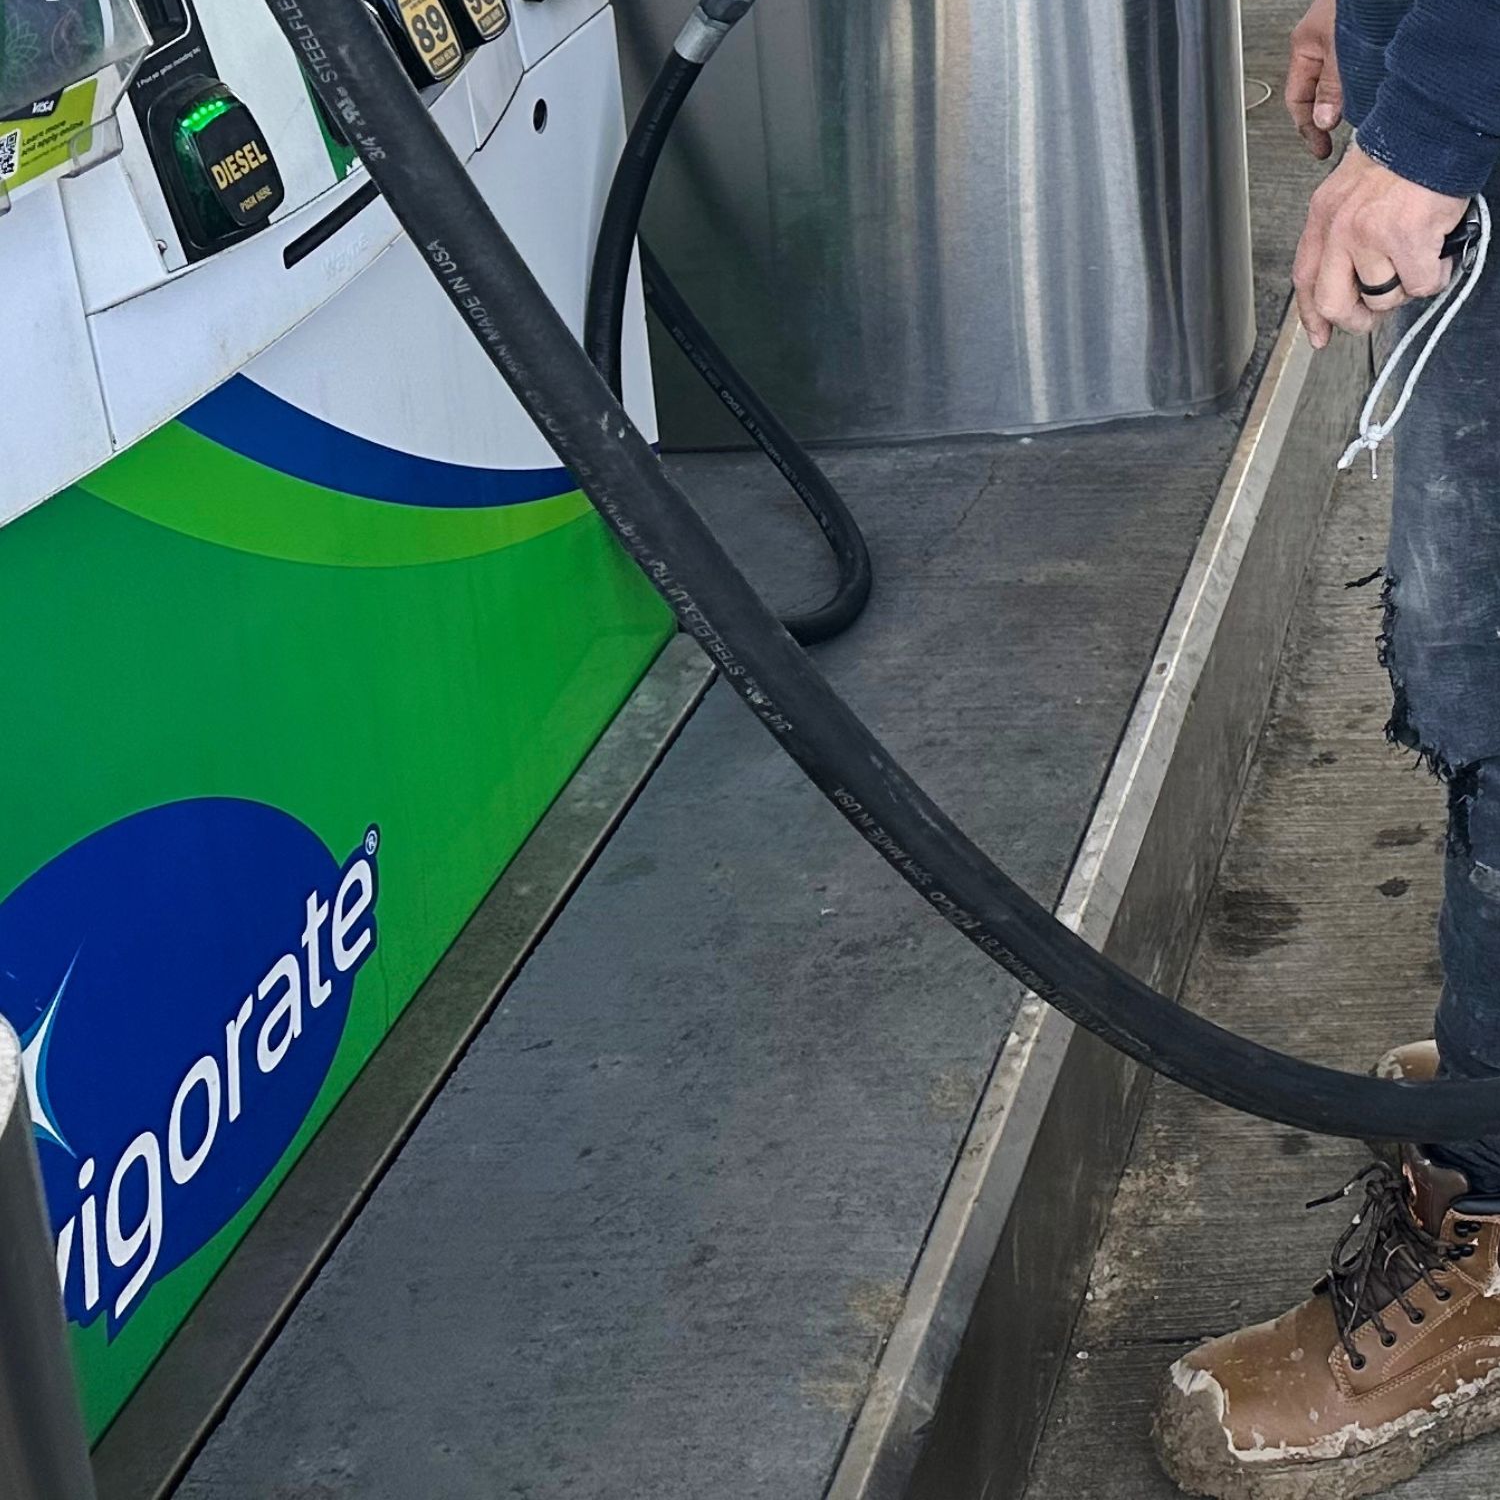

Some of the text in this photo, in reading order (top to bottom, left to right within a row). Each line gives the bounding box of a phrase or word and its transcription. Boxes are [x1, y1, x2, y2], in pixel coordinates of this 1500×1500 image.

[410, 3, 449, 54] 89
[31, 100, 55, 115] VISA
[22, 119, 67, 147] Learn more
[211, 140, 268, 190] DIESEL
[425, 238, 458, 274] USA
[449, 276, 471, 295] IN
[462, 294, 501, 342] MADE
[833, 786, 863, 814] USA
